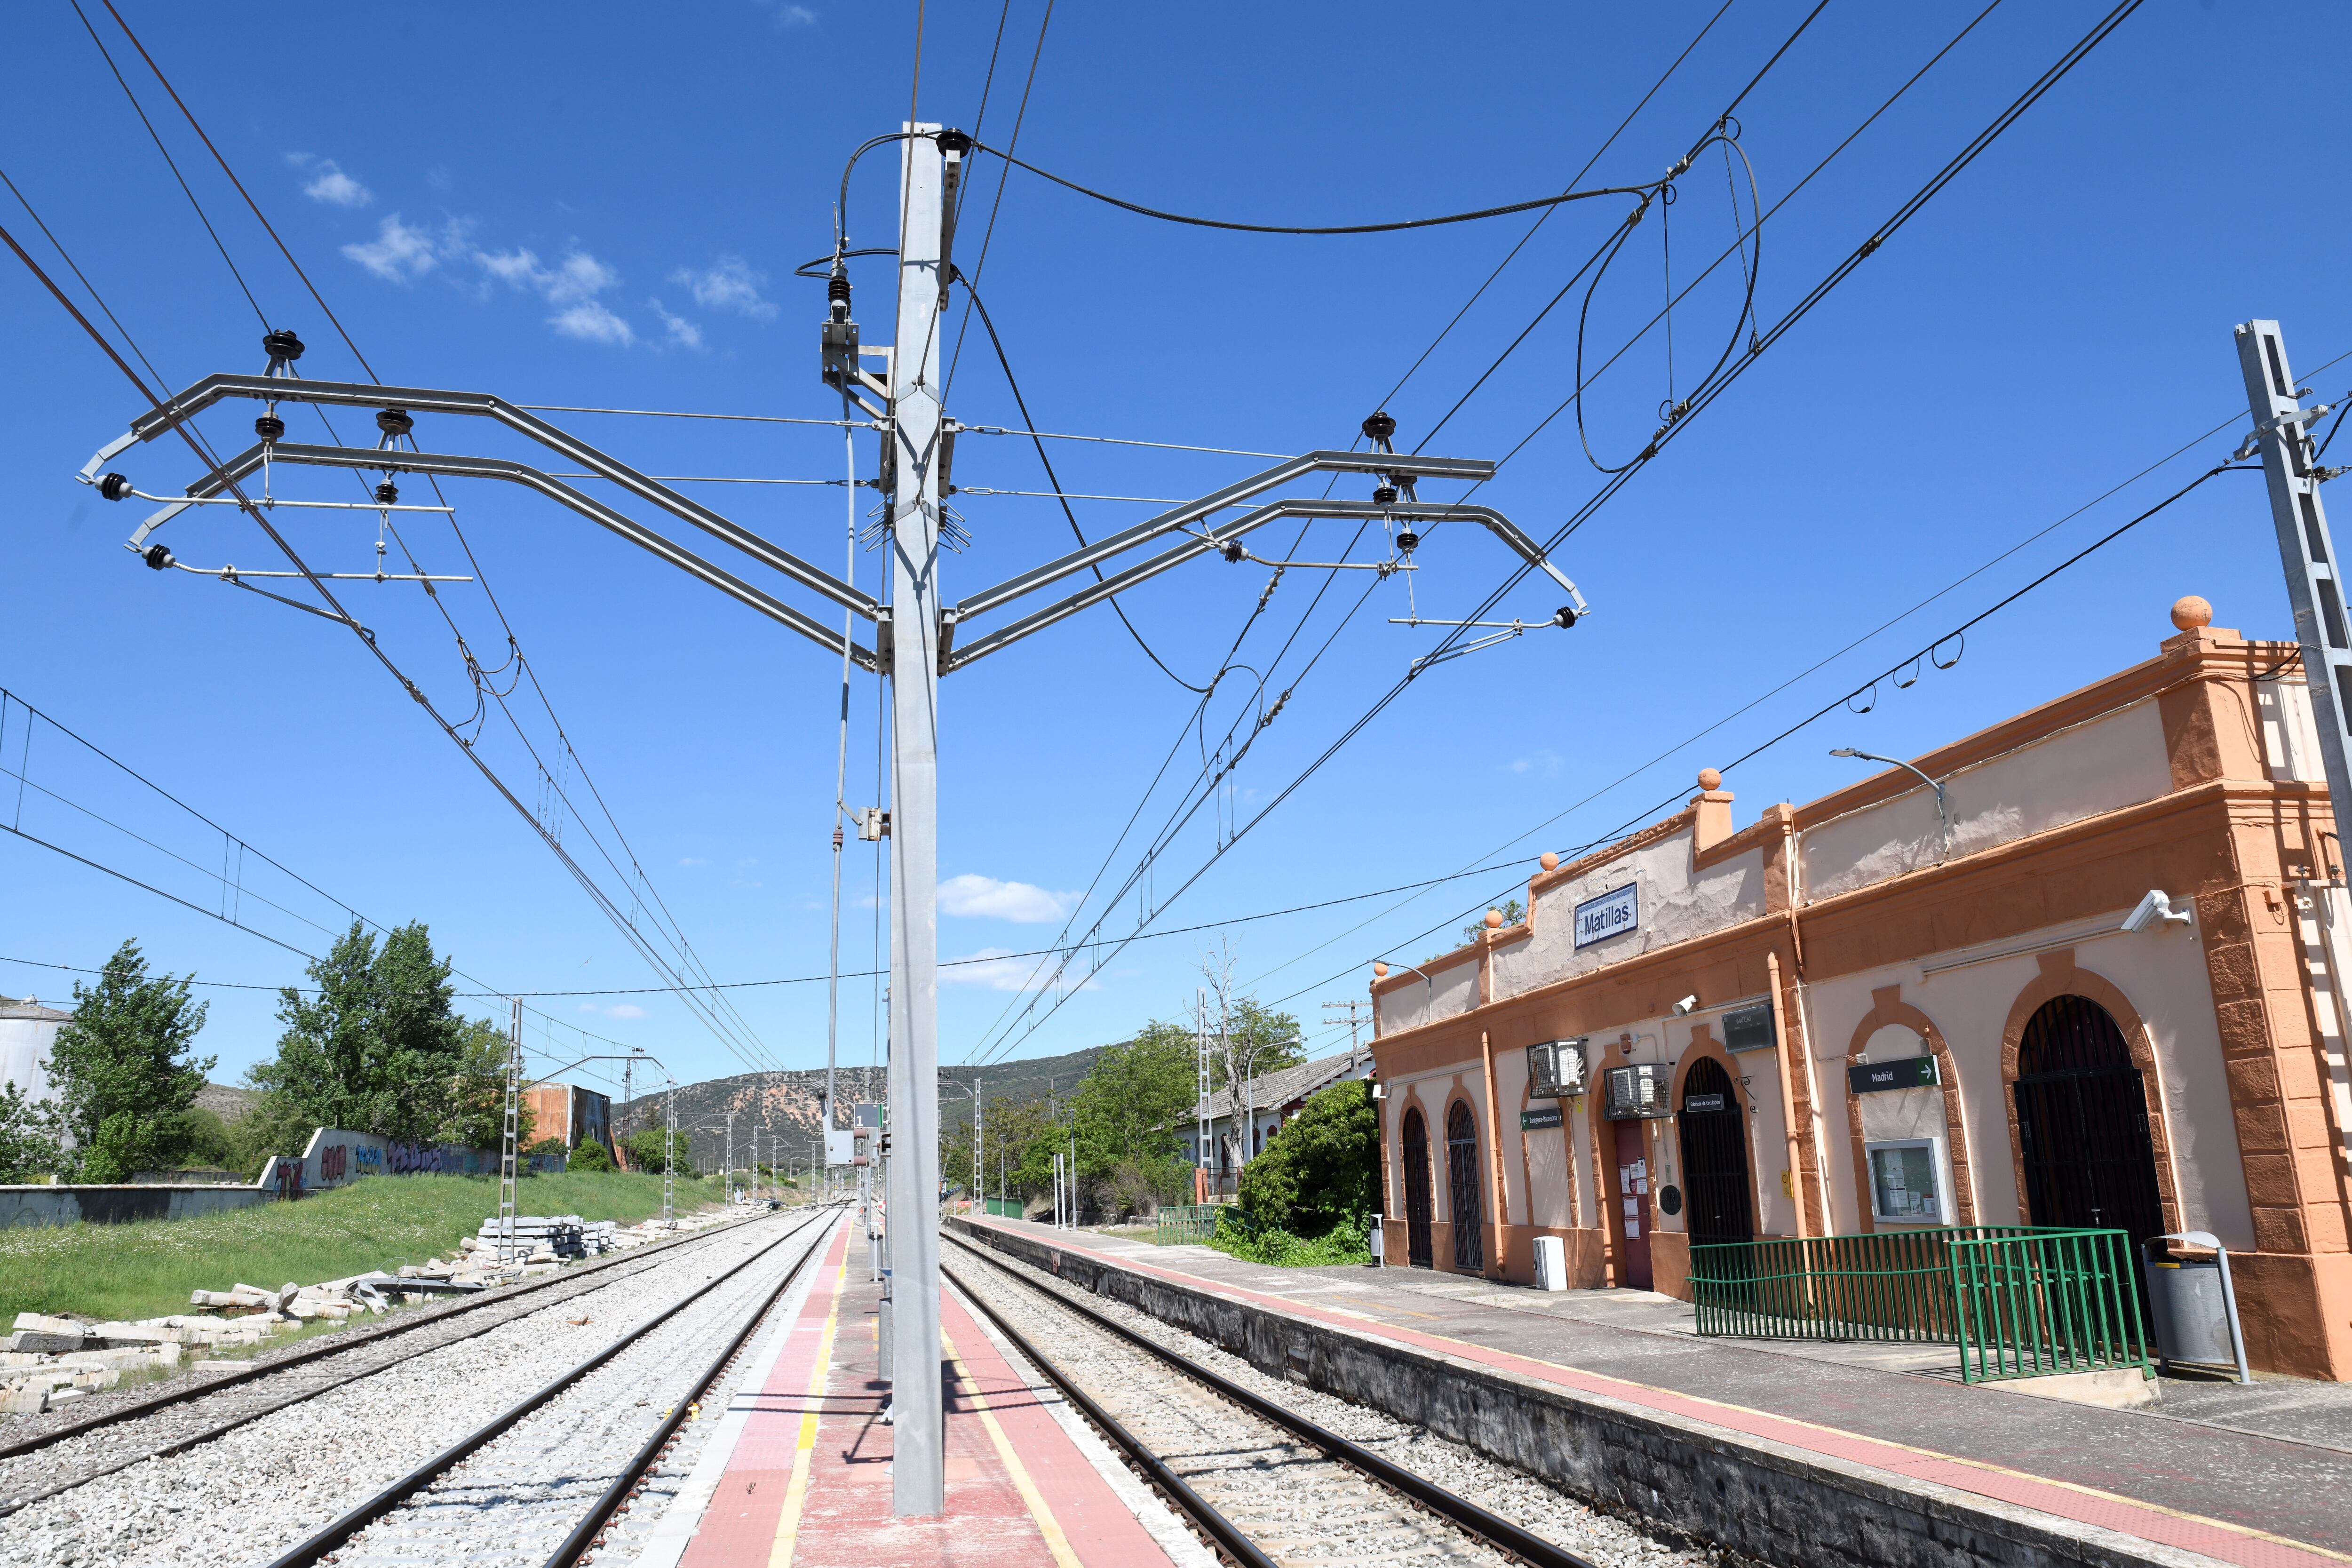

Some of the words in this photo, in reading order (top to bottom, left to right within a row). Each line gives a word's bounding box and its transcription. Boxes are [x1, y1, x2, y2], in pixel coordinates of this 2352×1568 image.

[1585, 905, 1629, 935] Matillas
[1872, 1071, 1893, 1082] Madrid
[857, 1115, 863, 1126] 1
[1529, 1115, 1557, 1124] Zaragoza-Barcelona
